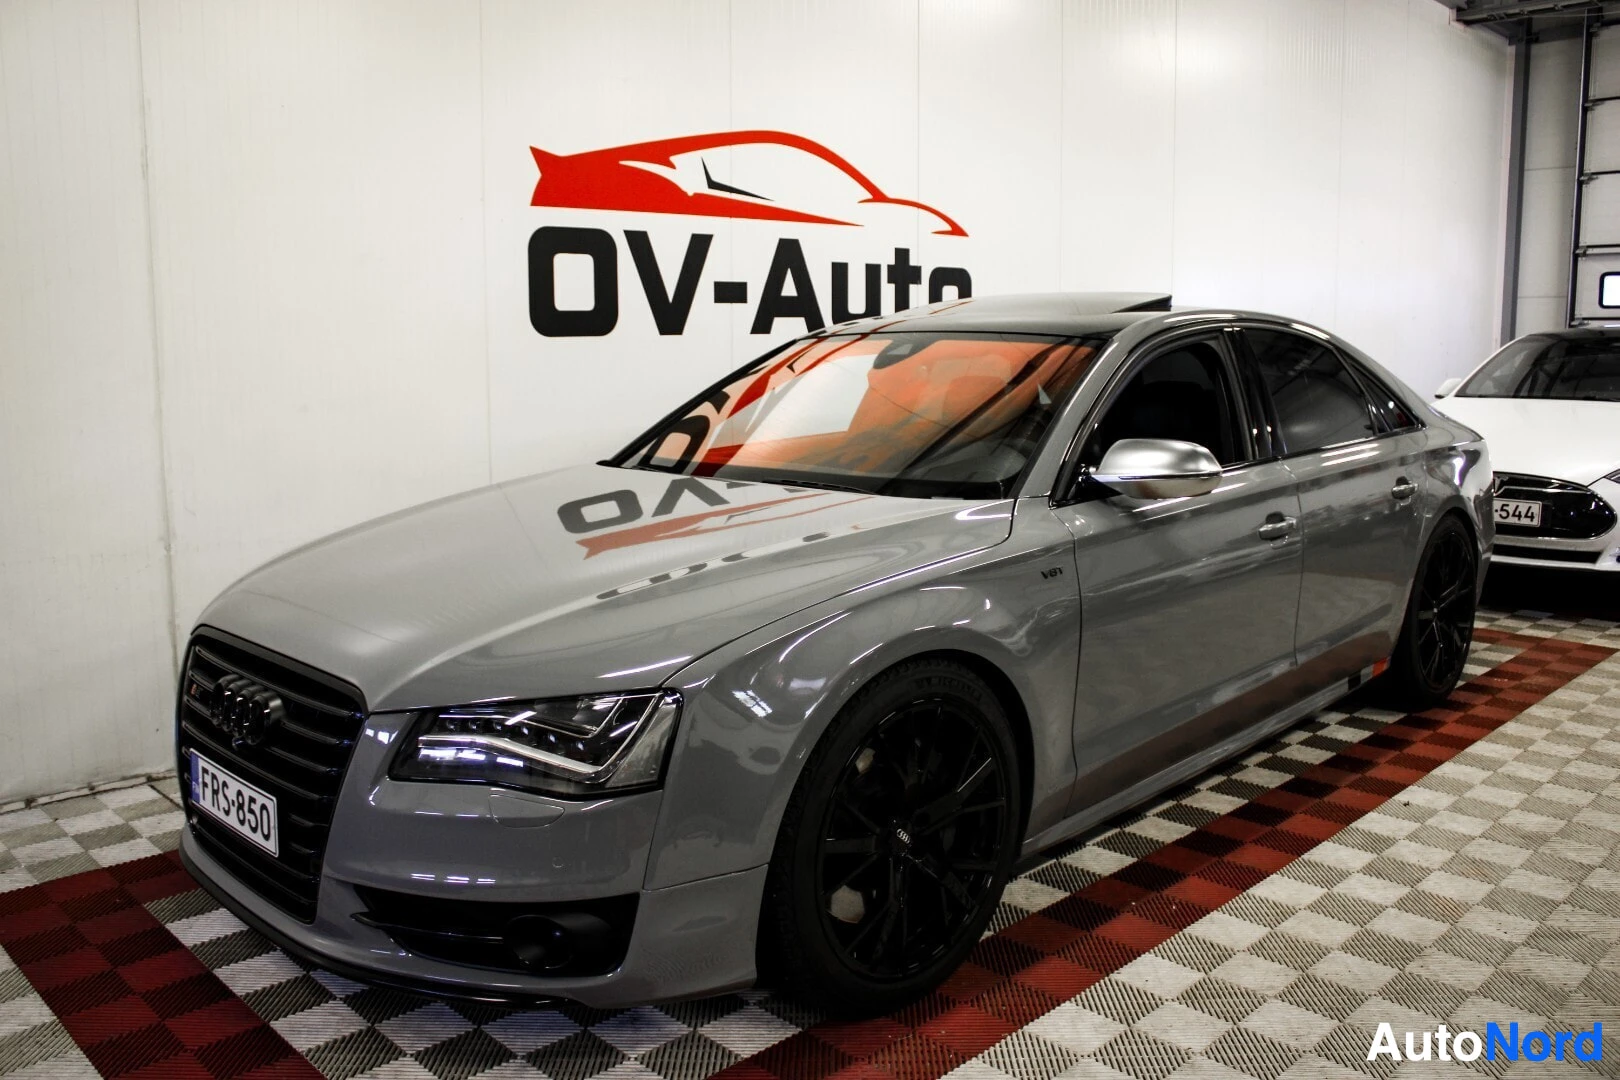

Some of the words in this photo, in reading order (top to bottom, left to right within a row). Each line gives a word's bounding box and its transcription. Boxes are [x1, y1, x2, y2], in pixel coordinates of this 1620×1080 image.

[528, 226, 972, 337] OV-Auto
[1494, 504, 1535, 522] -544
[201, 766, 271, 842] FRS-850
